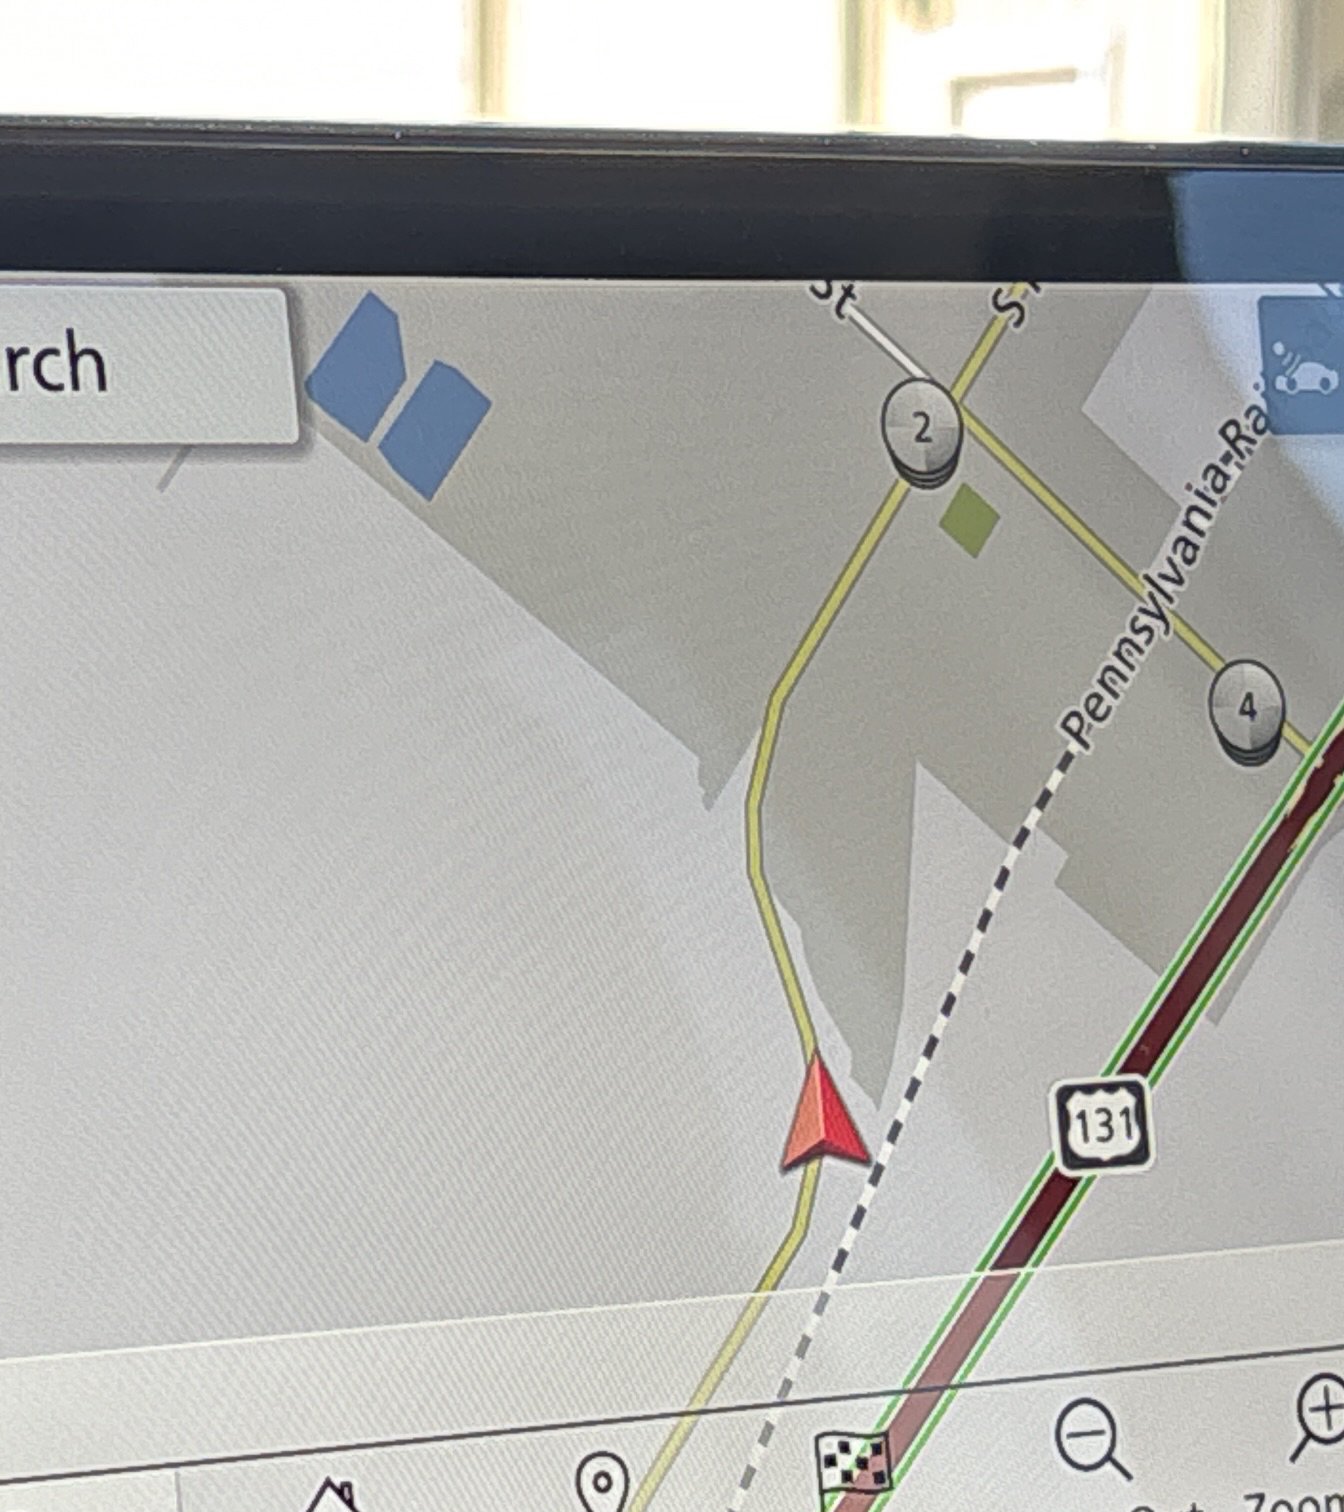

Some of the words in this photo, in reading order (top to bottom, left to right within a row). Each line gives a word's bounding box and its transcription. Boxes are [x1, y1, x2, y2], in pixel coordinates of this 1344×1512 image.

[914, 412, 932, 443] 2
[1238, 691, 1257, 722] 4
[1075, 1105, 1134, 1145] 131
